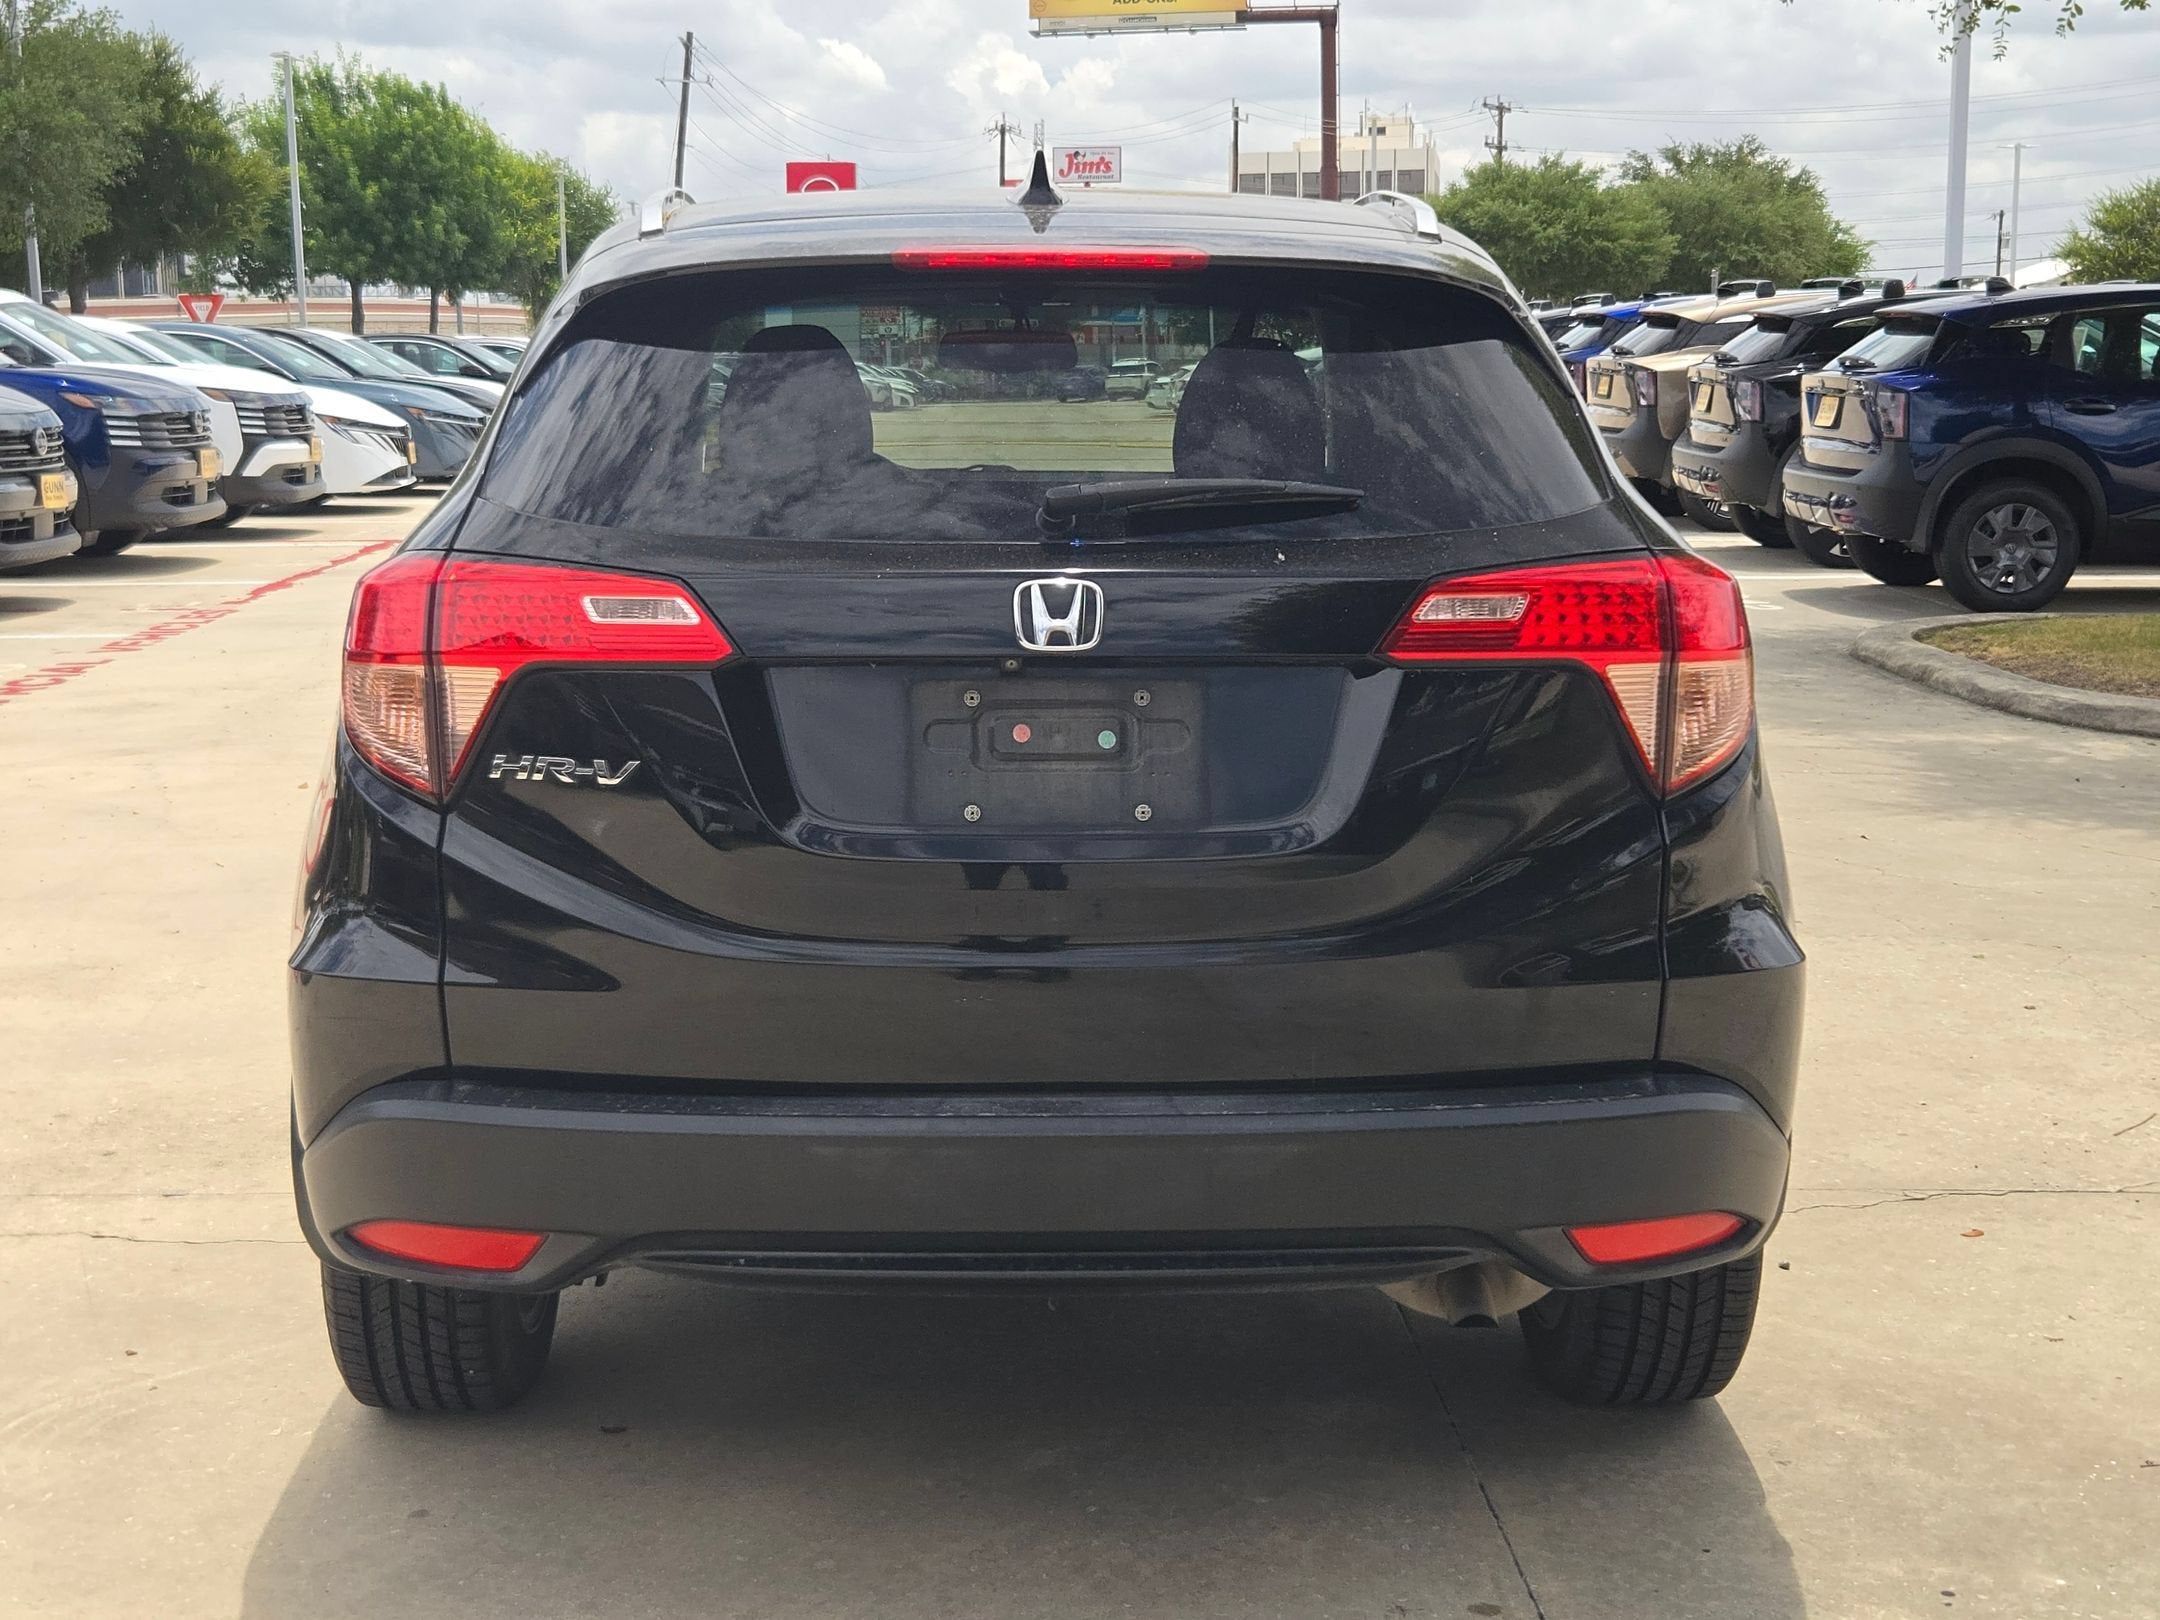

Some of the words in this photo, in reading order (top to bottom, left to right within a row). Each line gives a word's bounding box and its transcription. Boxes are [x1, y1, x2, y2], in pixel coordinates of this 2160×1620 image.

[1058, 153, 1113, 178] Jim's
[44, 481, 64, 493] GUNN
[0, 658, 116, 706] RCIAL
[85, 608, 241, 654] VEHICLES
[488, 754, 641, 785] HR-V
